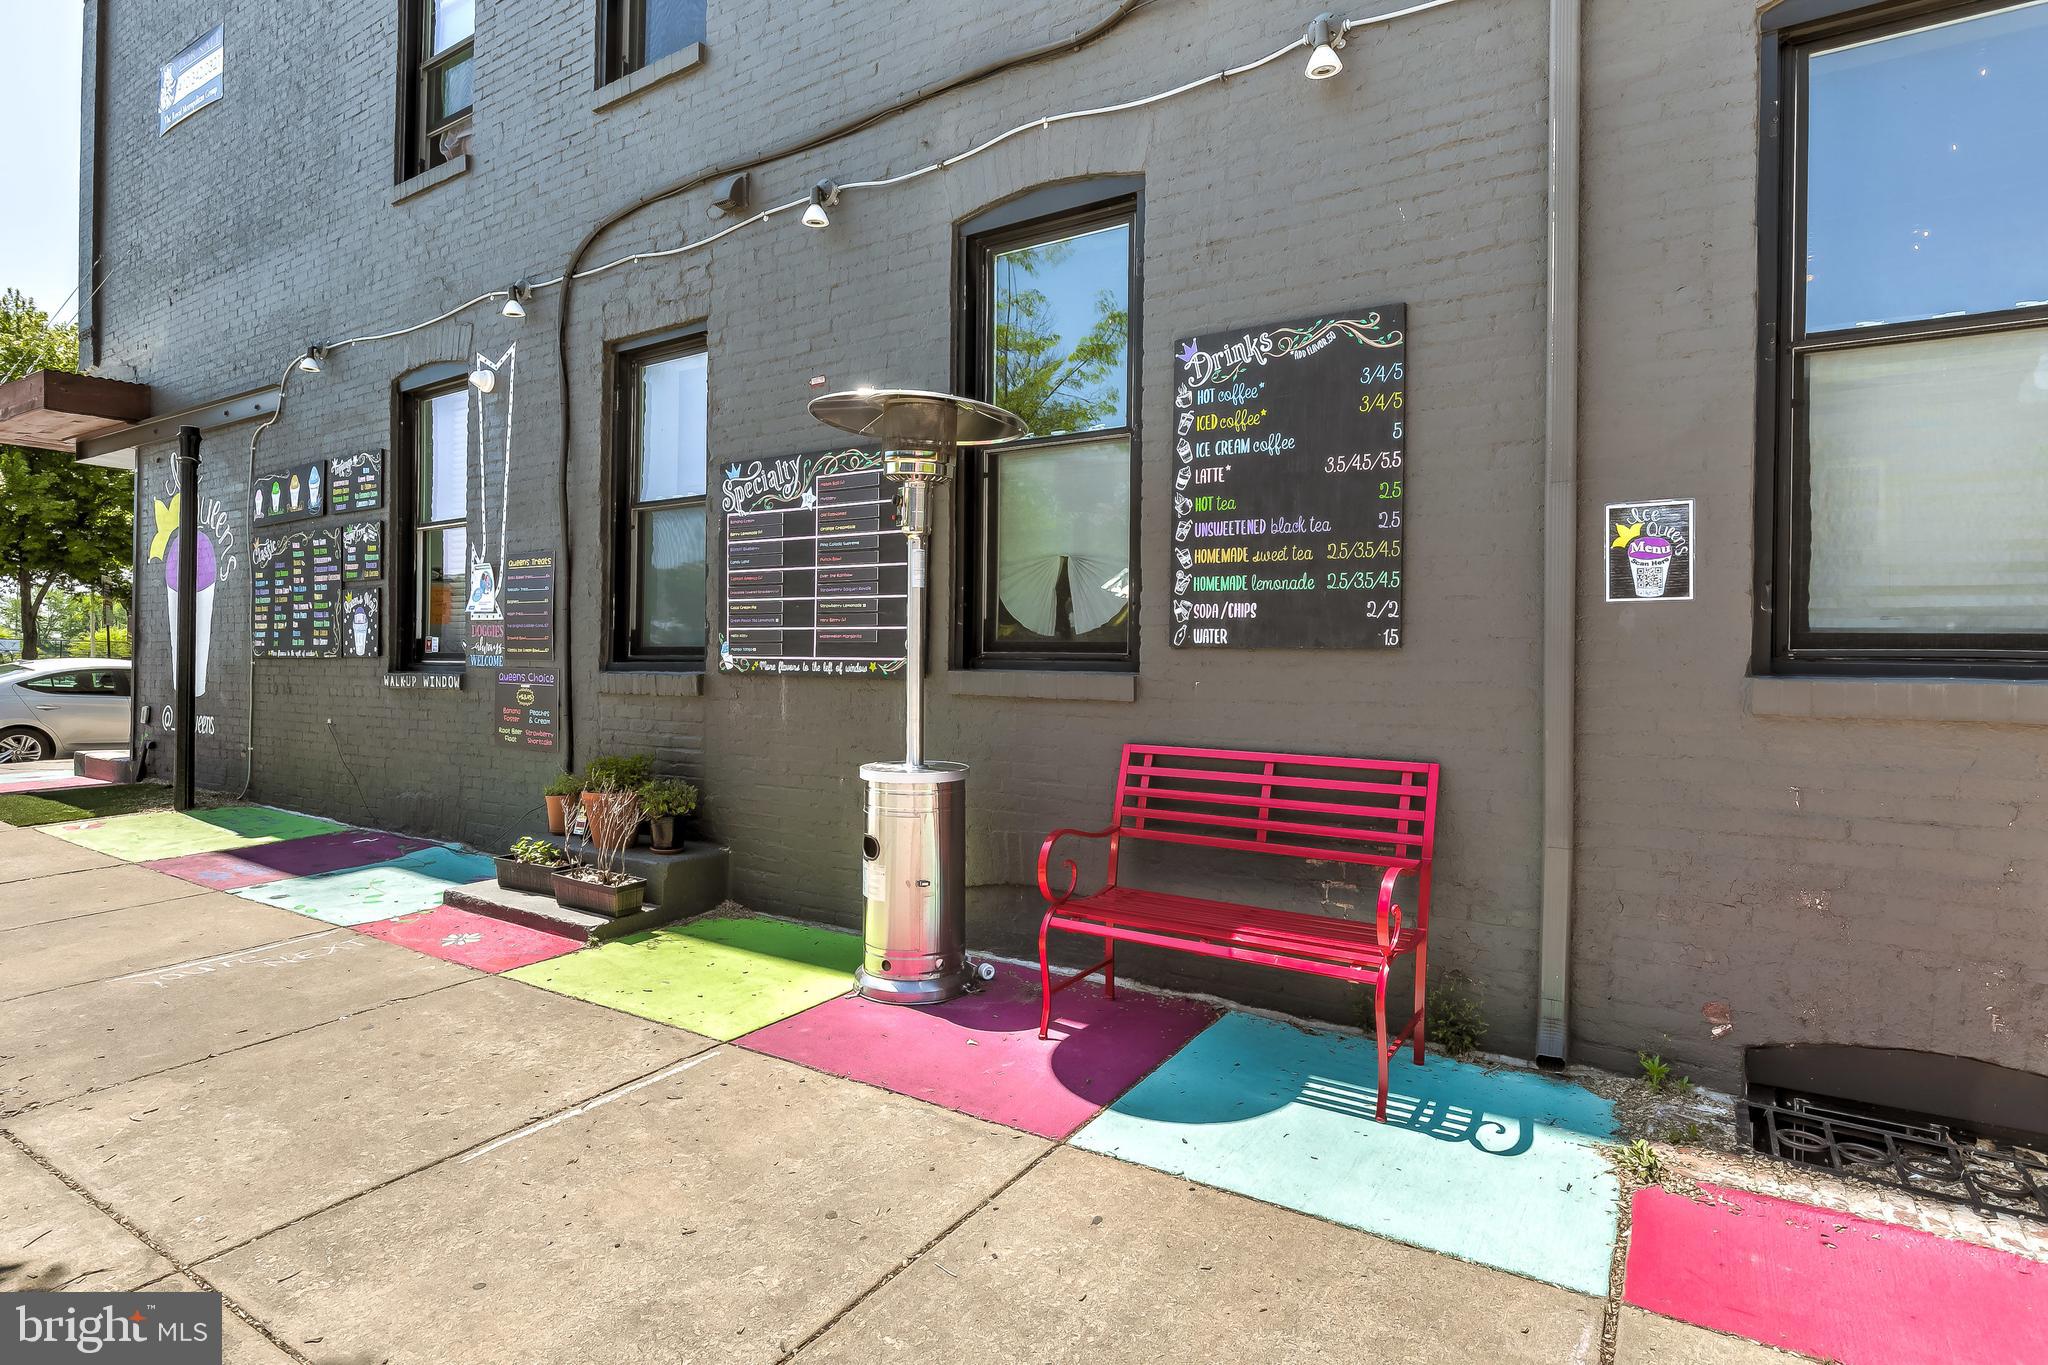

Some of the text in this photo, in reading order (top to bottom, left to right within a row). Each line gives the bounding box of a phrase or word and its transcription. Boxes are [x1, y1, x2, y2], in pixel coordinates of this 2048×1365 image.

[1184, 332, 1273, 387] Drinks
[1360, 363, 1403, 384] 3/4/5
[1198, 388, 1215, 405] HOT
[1359, 392, 1403, 412] 3/4/5
[1196, 412, 1217, 432] ICED
[1393, 422, 1403, 438] 5
[1196, 433, 1295, 458] ICE CREAM coffee
[722, 454, 801, 516] Specialty
[1379, 481, 1402, 499] 2.5
[1195, 496, 1236, 512] HOT tea
[1379, 511, 1400, 529] 2.5
[1627, 507, 1661, 524] Ice
[1195, 516, 1331, 538] UNSWEETENED black tea
[197, 494, 237, 581] ueens
[1647, 522, 1688, 556] Queens
[253, 539, 276, 564] Classic
[1194, 545, 1313, 564] HOMEMADE sweet tea
[1630, 541, 1671, 554] Menu
[531, 557, 551, 565] Treats
[1652, 558, 1670, 566] Here
[1193, 572, 1315, 592] HOMEMADE lemonade
[1366, 600, 1399, 619] 2/2
[471, 625, 504, 637] DOGGIES
[1193, 628, 1227, 644] WATER
[471, 636, 505, 654] always
[470, 655, 503, 667] WELCOME
[759, 661, 867, 674] More flavors to the left of window
[423, 675, 460, 688] WINDOW
[499, 672, 554, 683] Queens Choice
[529, 709, 550, 717] Peaches
[511, 727, 522, 735] Beer
[525, 729, 554, 737] Strawberry
[528, 737, 552, 745] Shortcake
